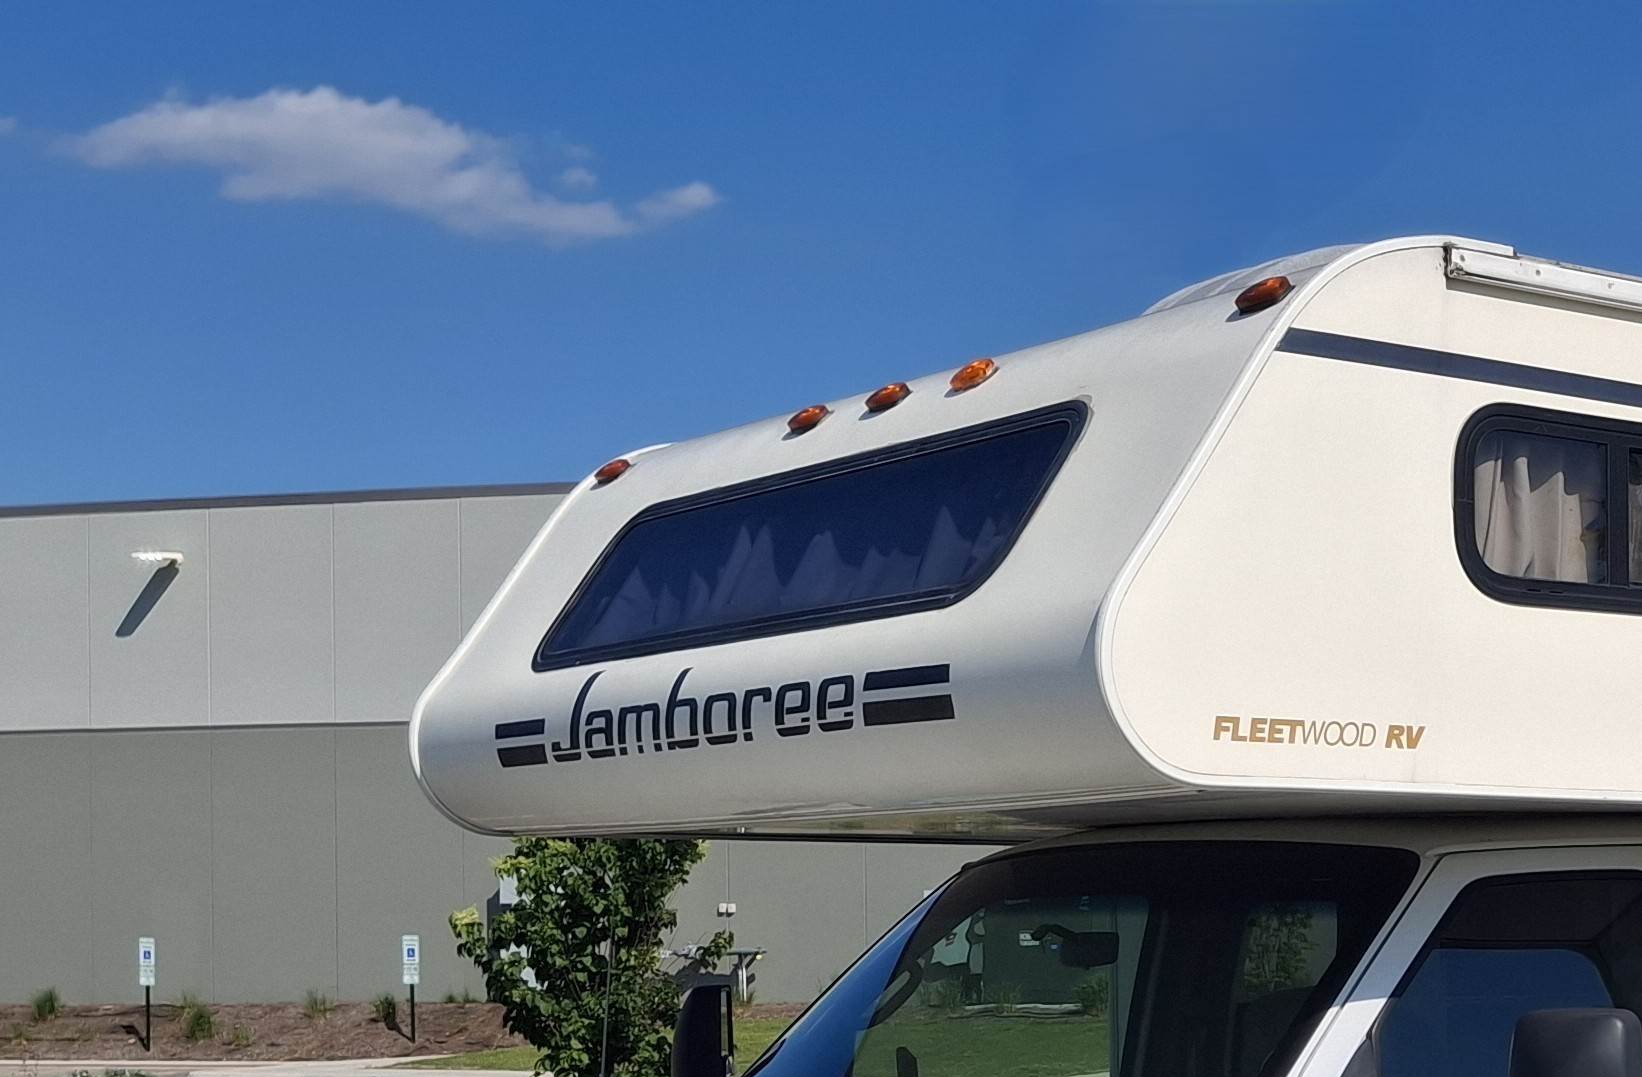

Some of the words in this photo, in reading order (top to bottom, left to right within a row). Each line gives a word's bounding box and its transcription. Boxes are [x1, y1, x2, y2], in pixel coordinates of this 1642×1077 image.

[550, 668, 855, 762] Jamboree
[1213, 716, 1376, 747] FLEETWOOD
[1384, 725, 1425, 749] RV
